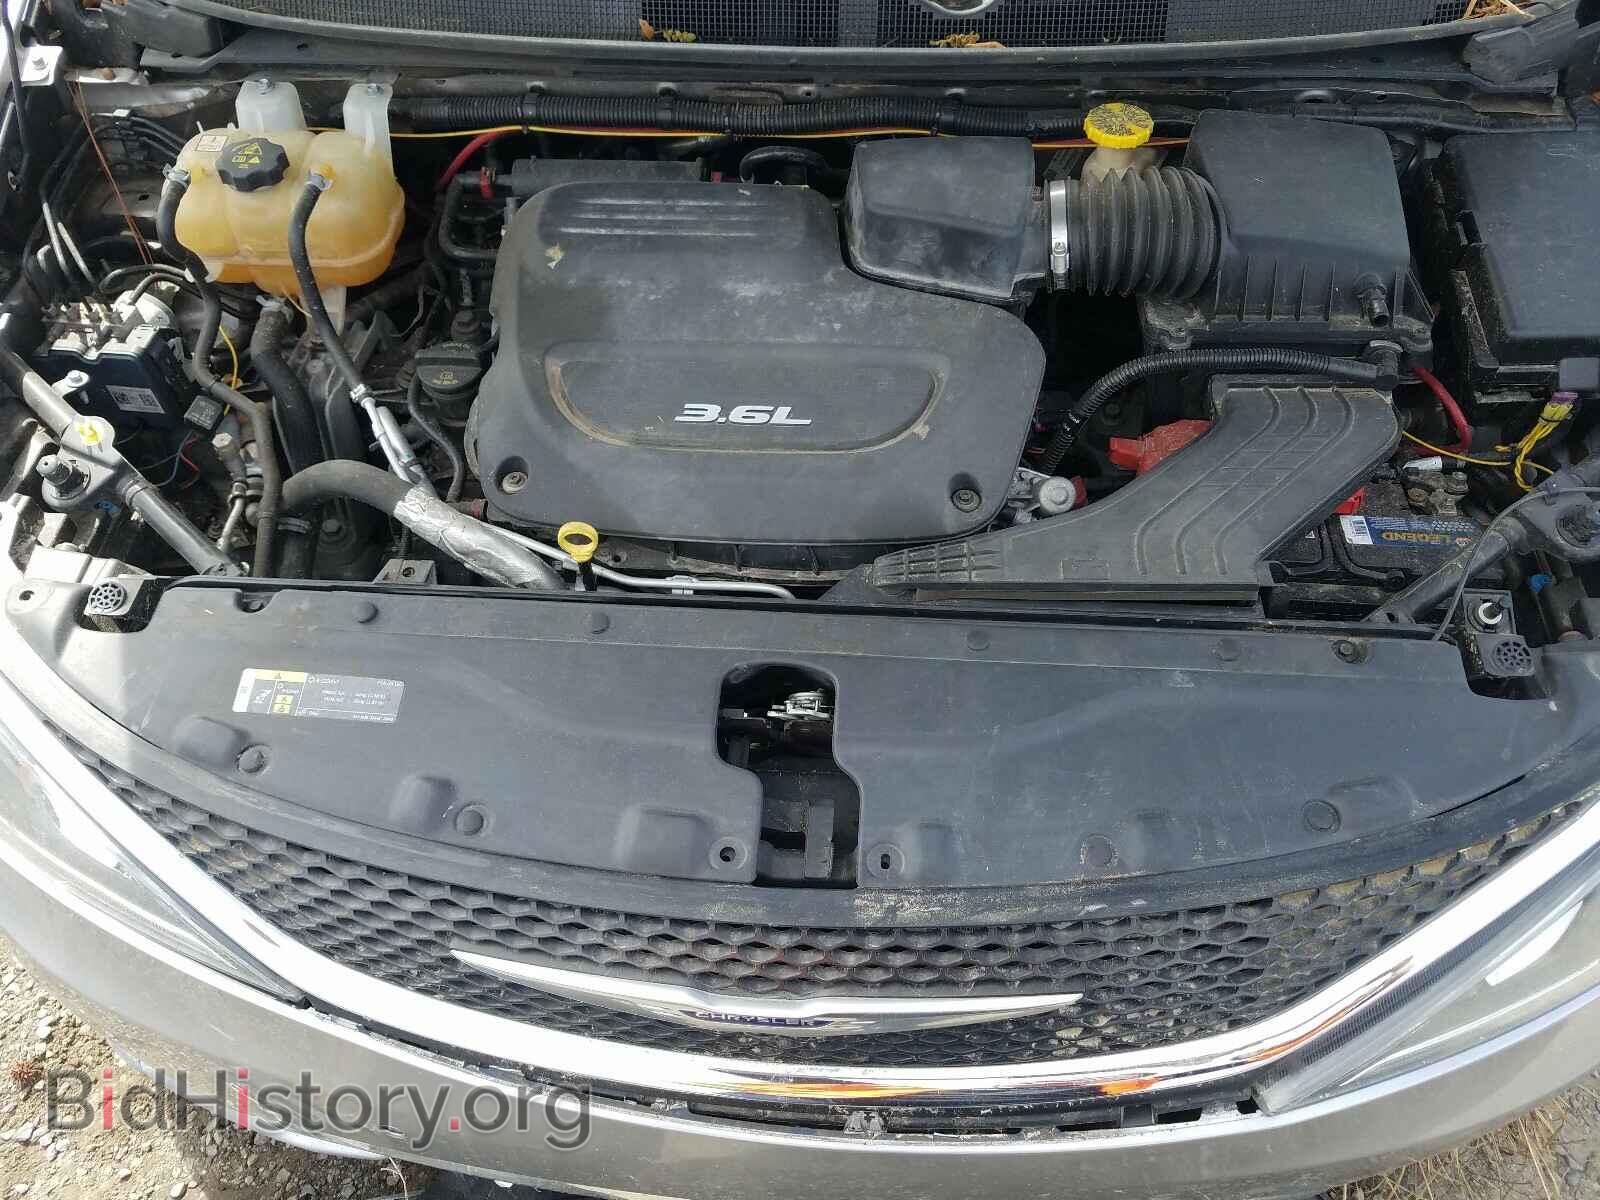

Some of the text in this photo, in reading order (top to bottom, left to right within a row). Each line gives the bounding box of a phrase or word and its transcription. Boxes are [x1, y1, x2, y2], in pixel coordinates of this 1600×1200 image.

[674, 403, 812, 425] 3.6L
[1381, 531, 1451, 545] LEGEND
[695, 1011, 815, 1026] CHRYSLER
